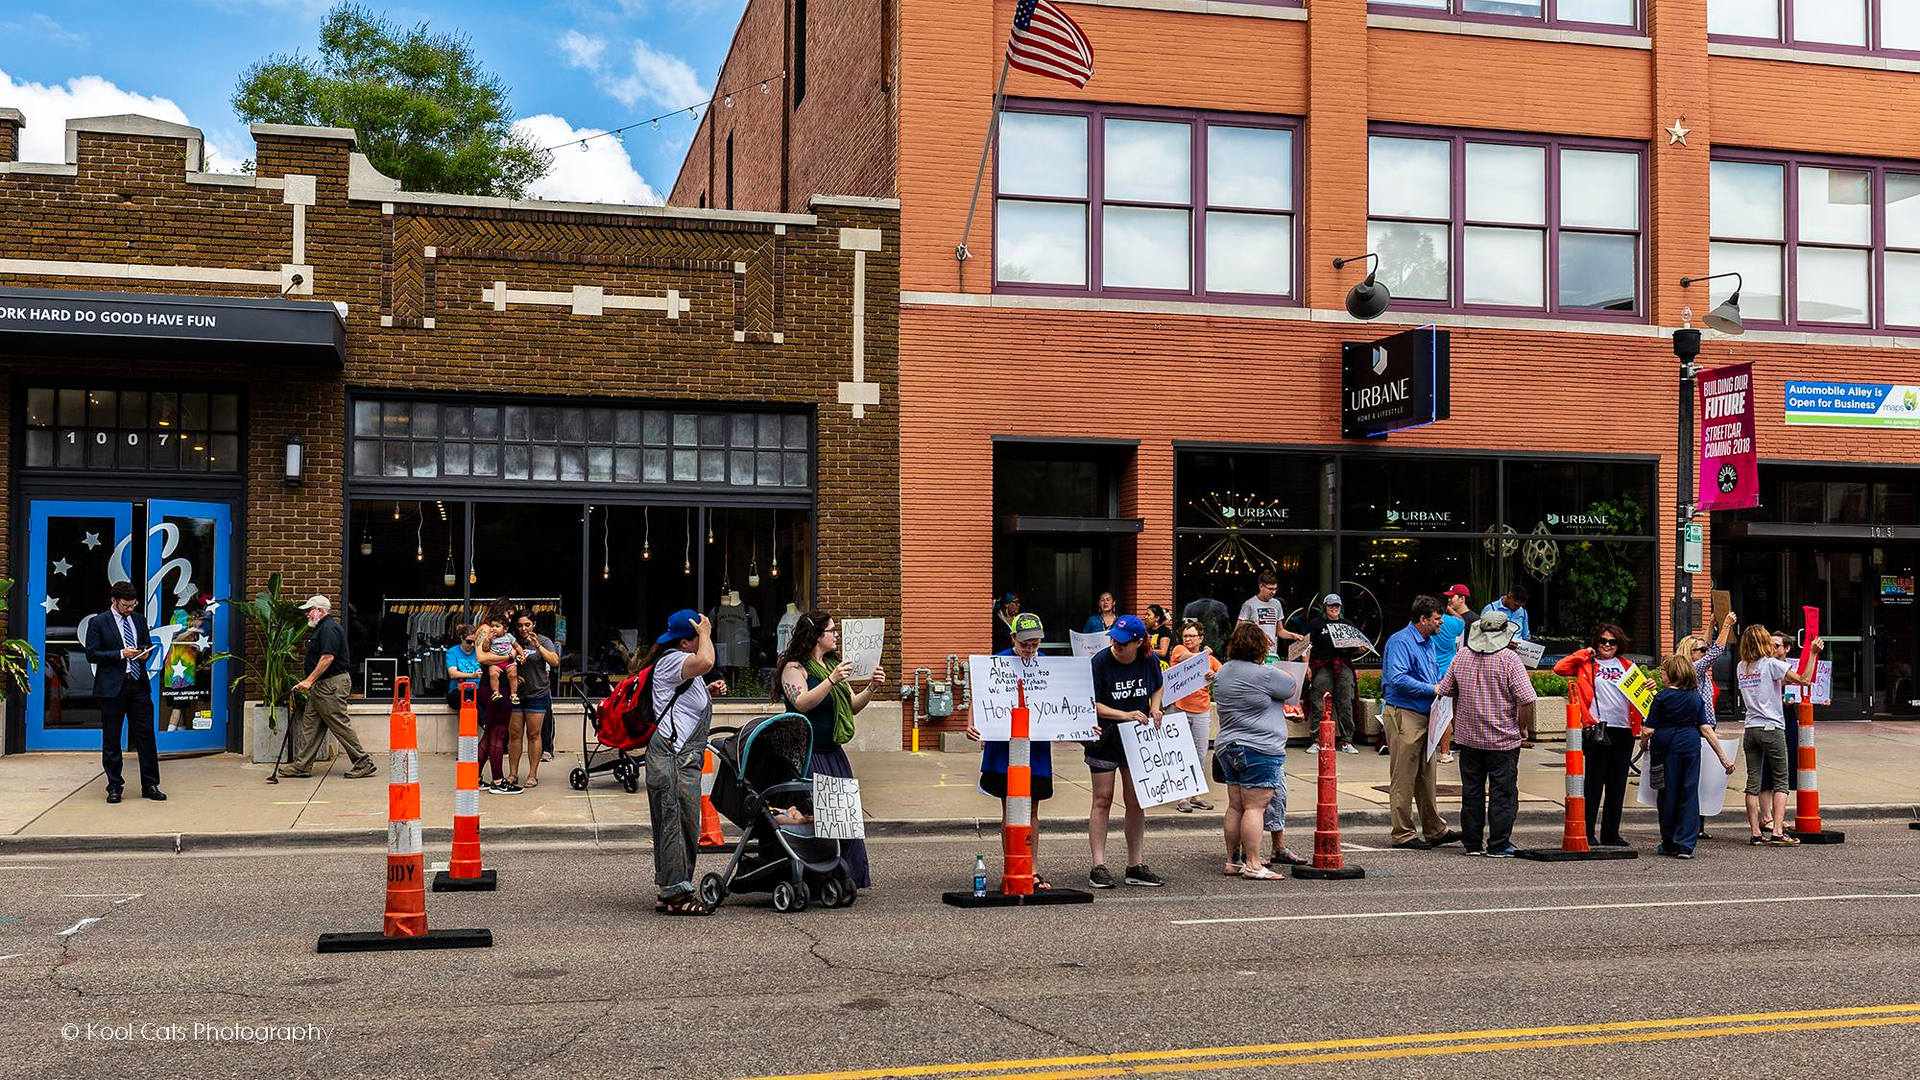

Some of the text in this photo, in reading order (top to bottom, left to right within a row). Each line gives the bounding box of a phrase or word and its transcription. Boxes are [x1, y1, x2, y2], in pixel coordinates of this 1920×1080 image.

[30, 308, 71, 321] HARD
[75, 310, 96, 322] DO
[100, 311, 143, 324] GOOD
[147, 313, 184, 326] HAVE
[187, 315, 216, 328] FUN
[1703, 374, 1749, 397] BUILDING OUR
[1789, 385, 1883, 398] Automobile Alley is
[1351, 377, 1409, 410] URBANE
[1704, 391, 1746, 420] FUTURE
[1789, 398, 1875, 409] Open for Business
[1883, 398, 1913, 414] maps 3
[67, 431, 169, 446] 1007
[1705, 422, 1742, 442] STREETCAR
[1704, 437, 1750, 458] COMING 2018
[1237, 507, 1289, 518] URBANE
[1401, 511, 1451, 521] URBANE
[1561, 515, 1609, 524] URBANE
[1886, 586, 1907, 594] ARTS
[844, 620, 863, 635] NO
[845, 653, 861, 663] NO
[990, 656, 1010, 668] The
[851, 663, 869, 677] ALL
[1038, 669, 1050, 677] too
[1115, 678, 1143, 691] ELECT
[1624, 670, 1640, 688] SEEKING
[989, 686, 1000, 694] We
[1633, 681, 1646, 698] ASYL
[1034, 701, 1058, 724] you
[1134, 723, 1180, 744] Families
[1139, 741, 1185, 773] Belong
[816, 775, 859, 794] BABIES
[816, 792, 855, 809] NEED
[816, 807, 858, 822] THEIR
[815, 820, 864, 838] FAMILIES
